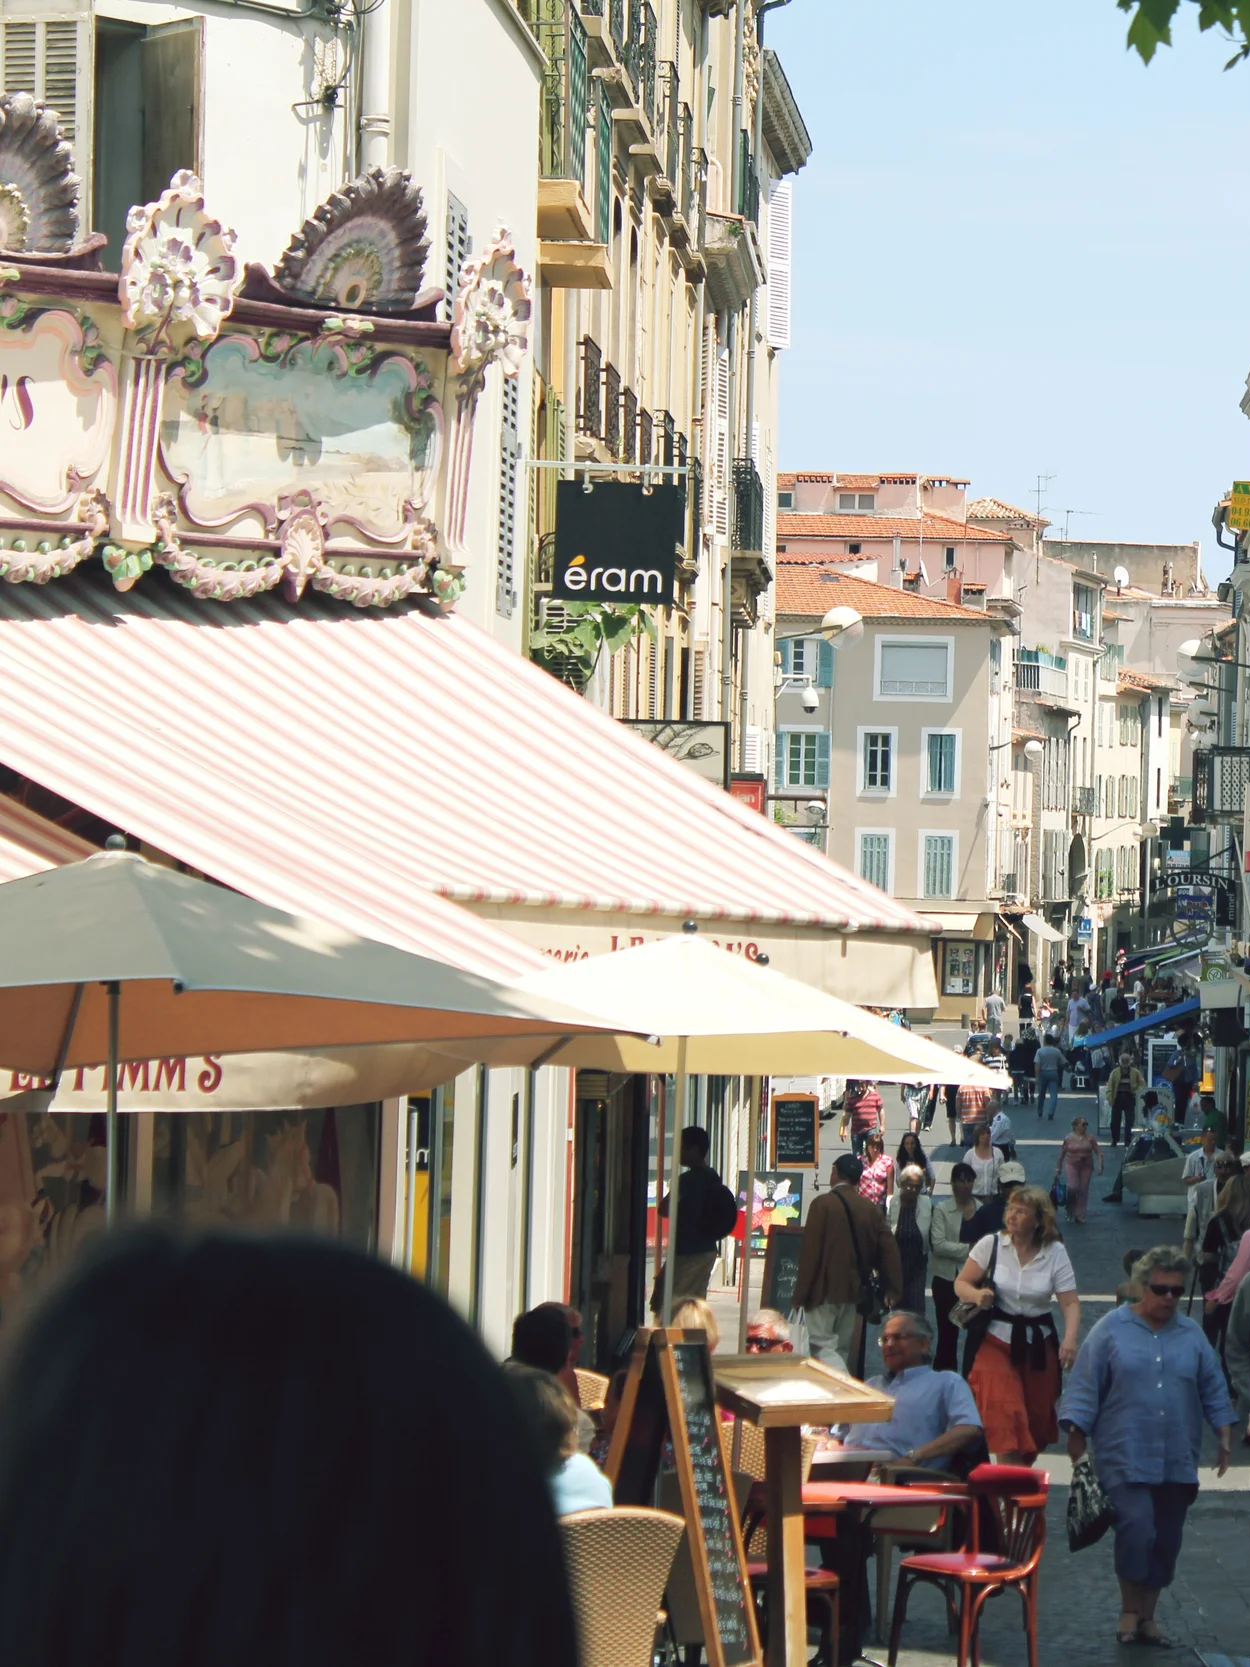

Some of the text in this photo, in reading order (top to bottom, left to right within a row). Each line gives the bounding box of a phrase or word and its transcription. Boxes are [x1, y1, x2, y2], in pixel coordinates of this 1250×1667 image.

[1236, 484, 1244, 494] A
[564, 555, 662, 593] éram
[1155, 874, 1228, 890] L'OURSIN
[72, 1055, 223, 1093] PIMMS
